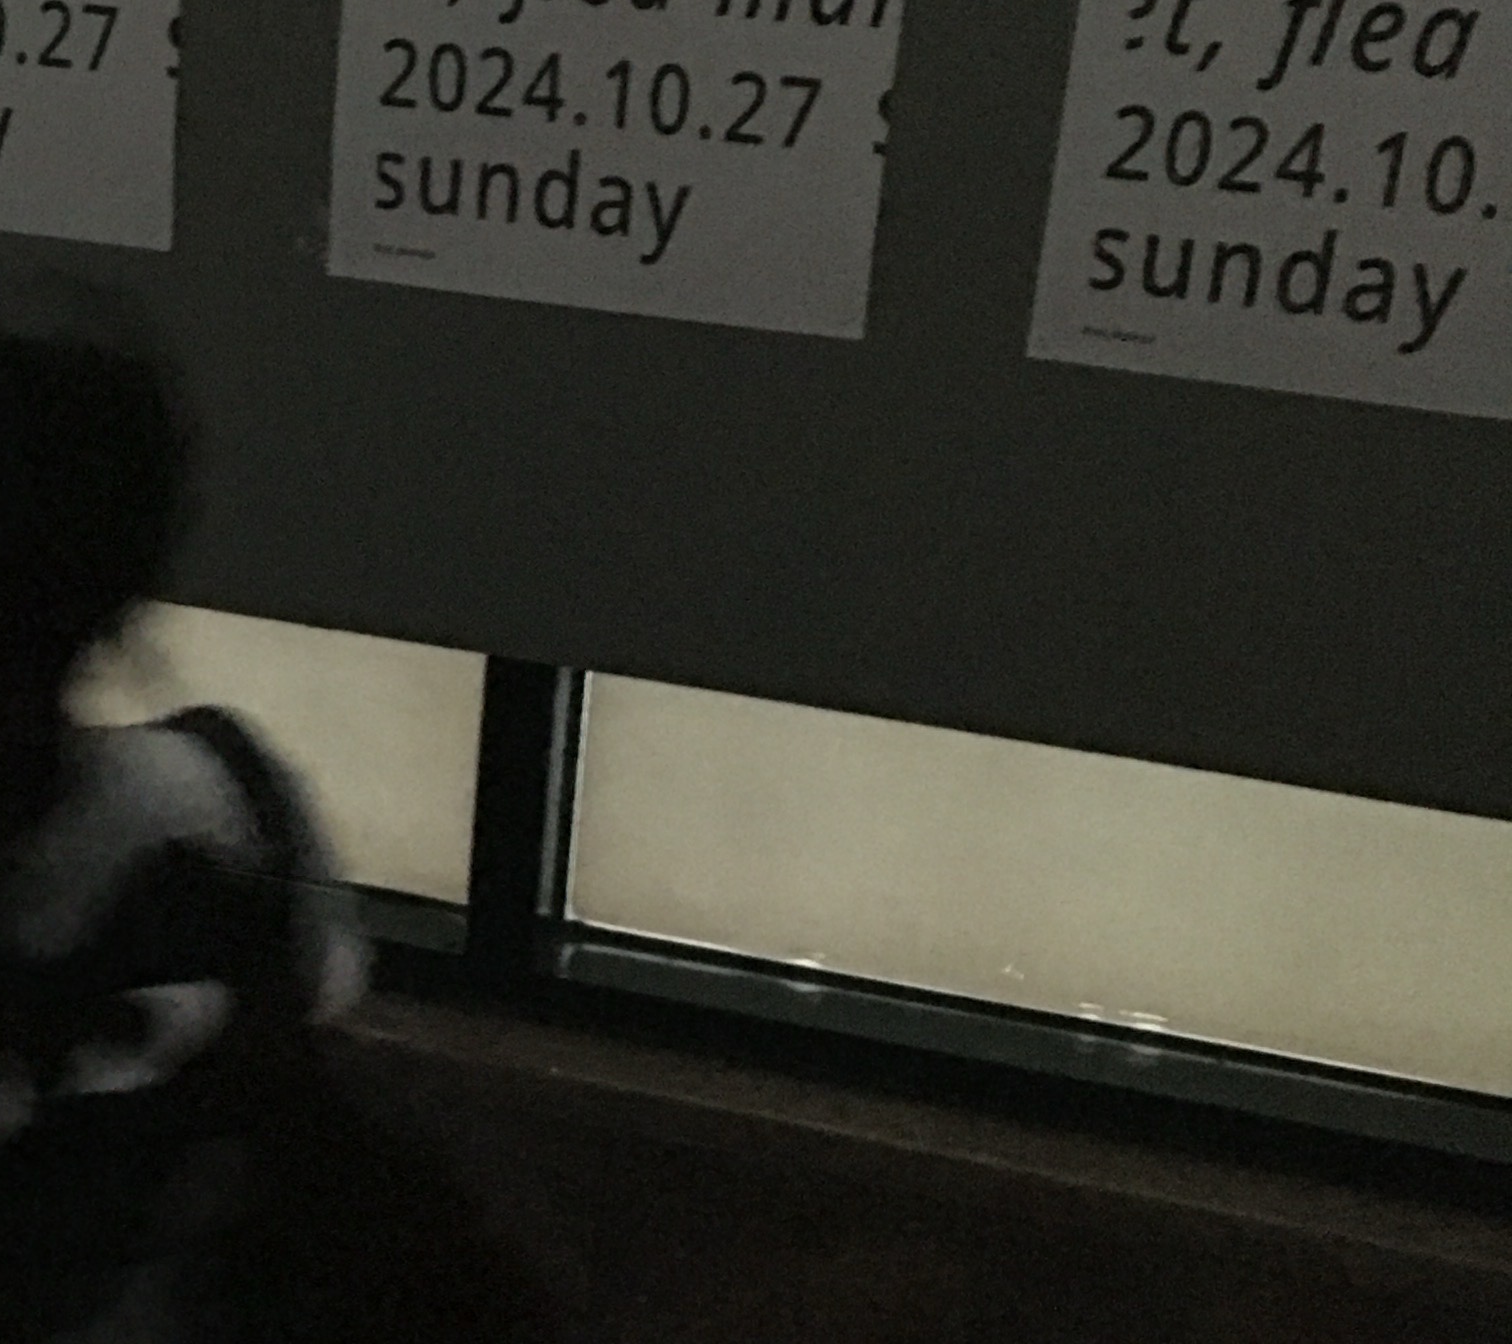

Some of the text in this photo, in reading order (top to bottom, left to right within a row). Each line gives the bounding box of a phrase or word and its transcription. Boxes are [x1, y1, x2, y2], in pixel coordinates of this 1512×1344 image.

[379, 40, 822, 149] 2024.10.27
[374, 150, 691, 264] sunday
[1103, 105, 1499, 220] 2024.10.
[1089, 223, 1467, 355] sunday
